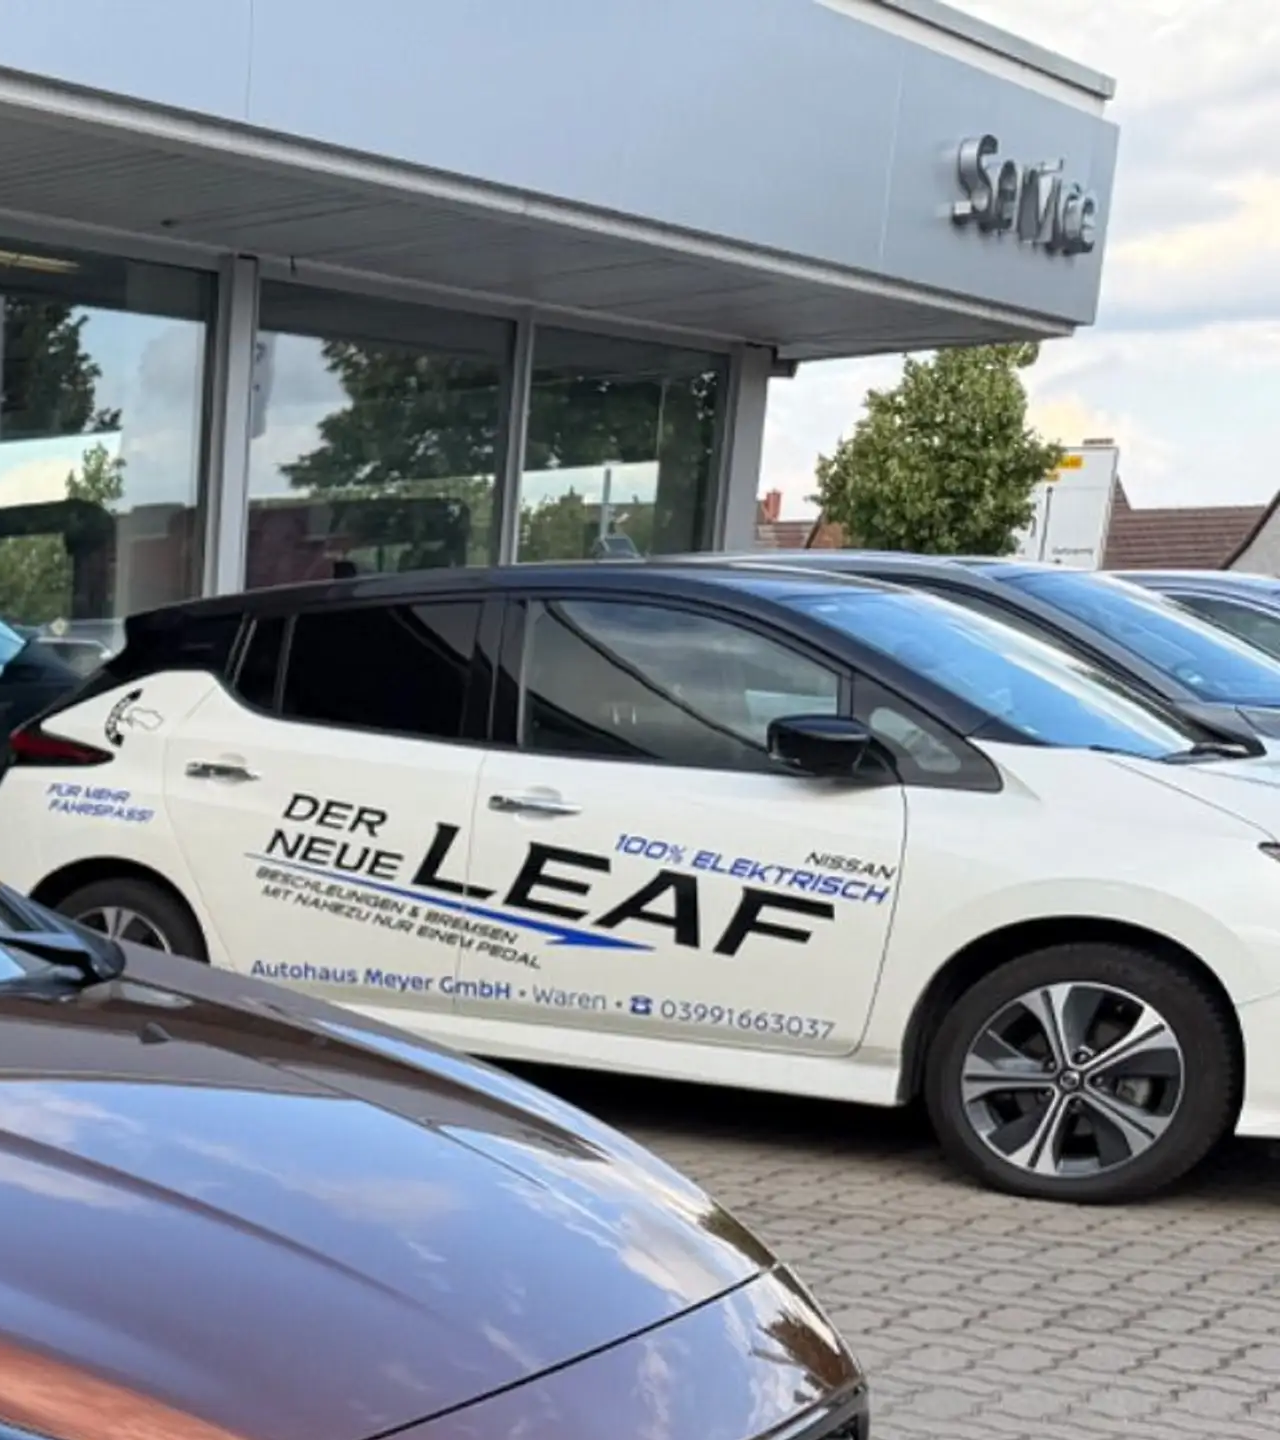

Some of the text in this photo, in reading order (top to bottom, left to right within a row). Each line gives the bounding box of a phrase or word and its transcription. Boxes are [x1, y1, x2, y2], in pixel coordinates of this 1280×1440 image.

[283, 792, 388, 837] DER
[265, 829, 405, 880] NEUE
[614, 833, 892, 904] 100% ELEKTRISCH
[804, 851, 897, 880] NISSAN
[411, 821, 835, 957] LEAF
[261, 884, 292, 901] MIT
[295, 889, 372, 922] NAHEZU
[373, 913, 414, 935] NUR
[476, 940, 541, 969] PEDAL
[408, 903, 422, 918] &
[424, 908, 519, 945] BREMSEN
[251, 959, 836, 1040] Autohaus Meyer GmbH Waren 03991663037
